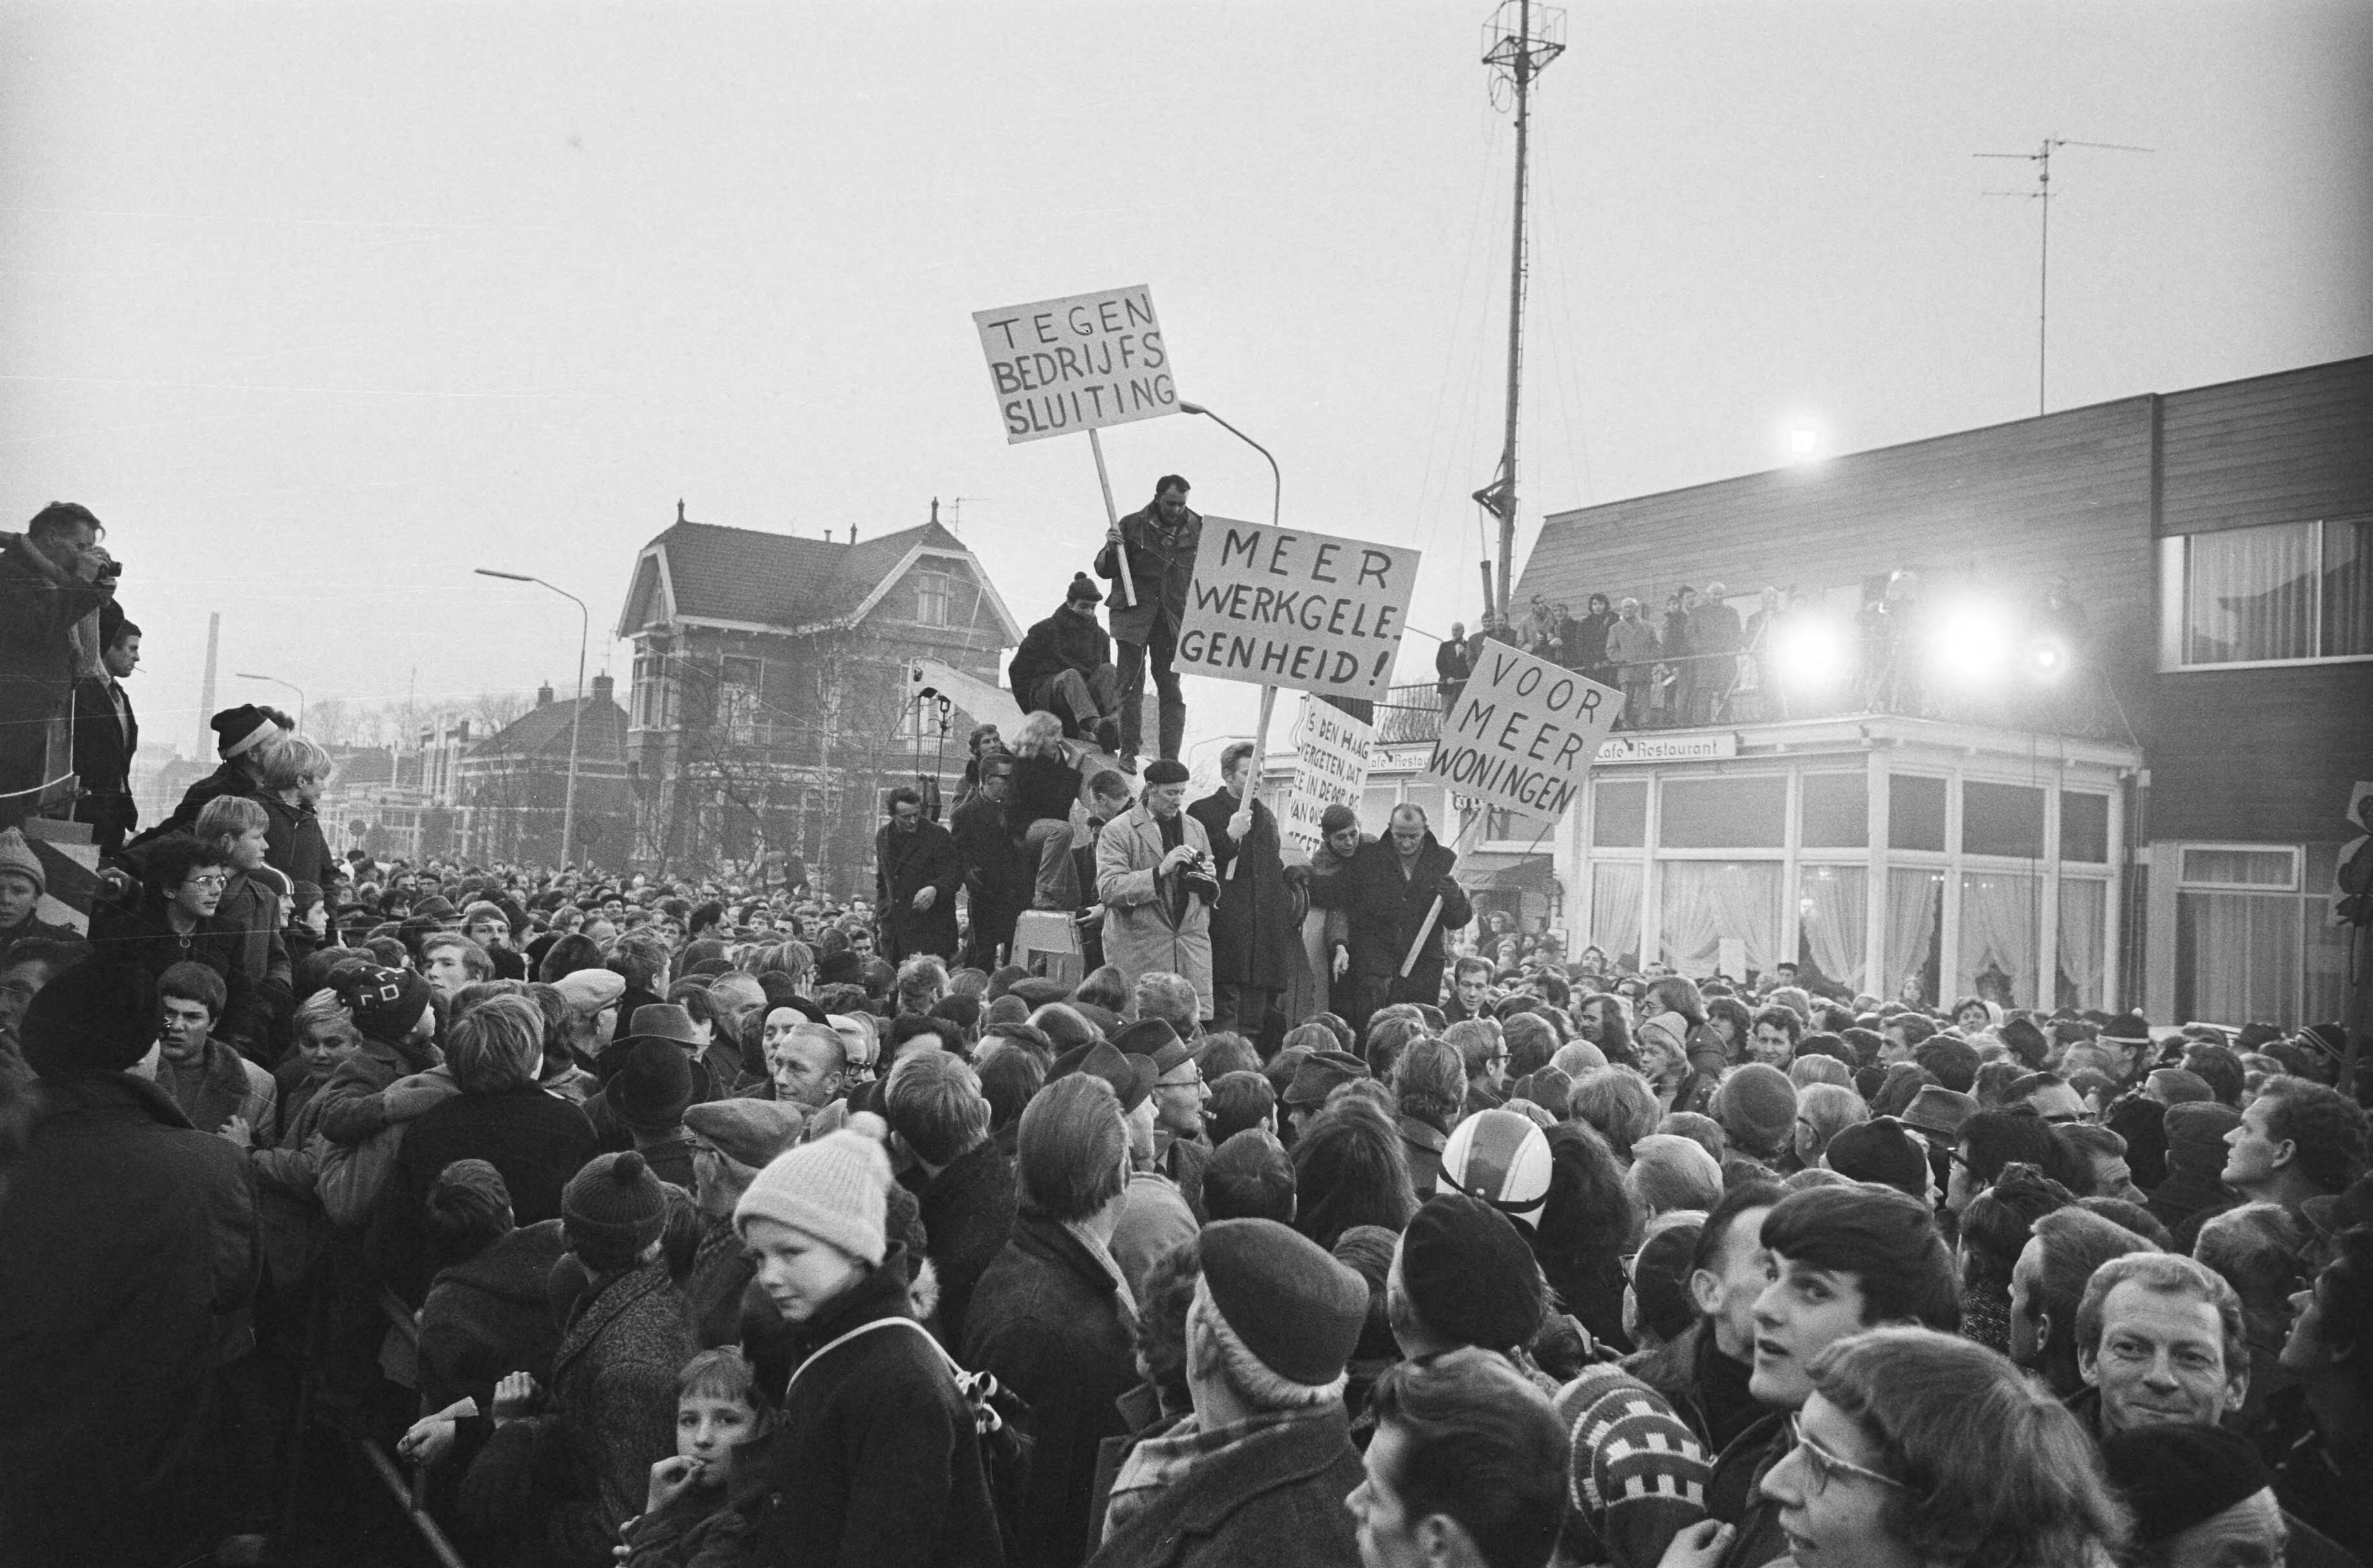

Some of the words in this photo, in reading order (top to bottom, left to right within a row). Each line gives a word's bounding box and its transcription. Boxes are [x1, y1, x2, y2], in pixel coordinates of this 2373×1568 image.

[988, 294, 1153, 348] TEGEN
[991, 331, 1164, 394] BEDRIJFS
[1004, 374, 1175, 435] SLUITING
[1220, 528, 1392, 589] MEER
[1180, 630, 1389, 686] GENHEID!
[1492, 653, 1601, 724] VOOR
[1319, 718, 1339, 744] DEN
[1341, 729, 1371, 760] HAAG
[1369, 755, 1386, 769] afe
[1458, 698, 1583, 771] MEER
[1638, 740, 1717, 757] Restaurant
[1294, 769, 1305, 790] ZE
[1319, 780, 1332, 801] DE
[1429, 738, 1577, 814] WONINGEN
[1290, 798, 1308, 822] VAN
